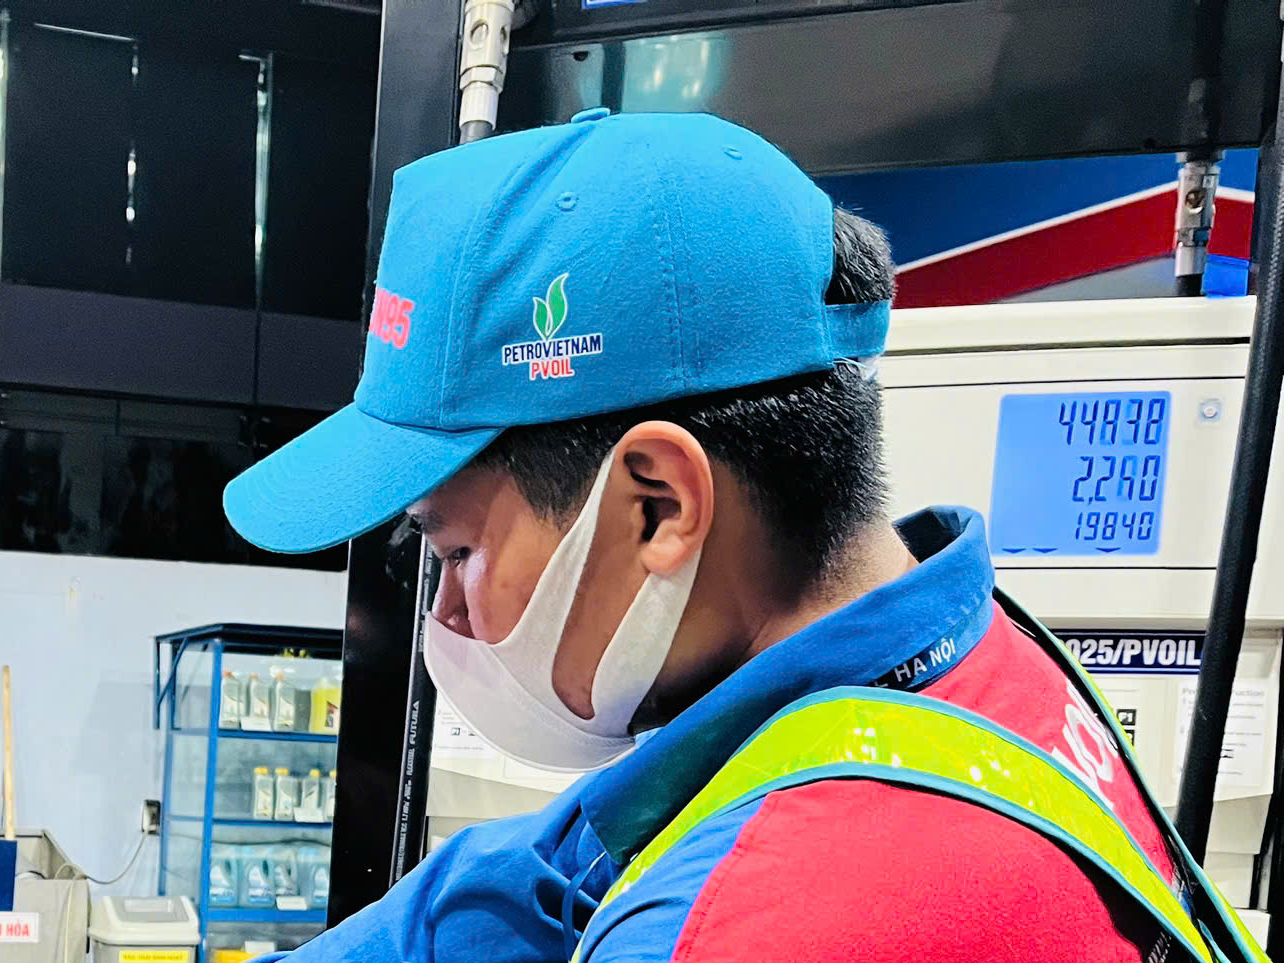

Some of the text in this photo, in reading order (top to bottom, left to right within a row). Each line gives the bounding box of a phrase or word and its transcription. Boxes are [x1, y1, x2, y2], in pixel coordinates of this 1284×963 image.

[369, 288, 413, 348] N95
[504, 334, 602, 364] PETROVIETNAM
[531, 358, 573, 379] PVOIL
[1074, 511, 1155, 541] 19840
[929, 636, 956, 667] NỘI
[1061, 638, 1202, 667] 025/PVOIL
[410, 700, 420, 745] FUTURA
